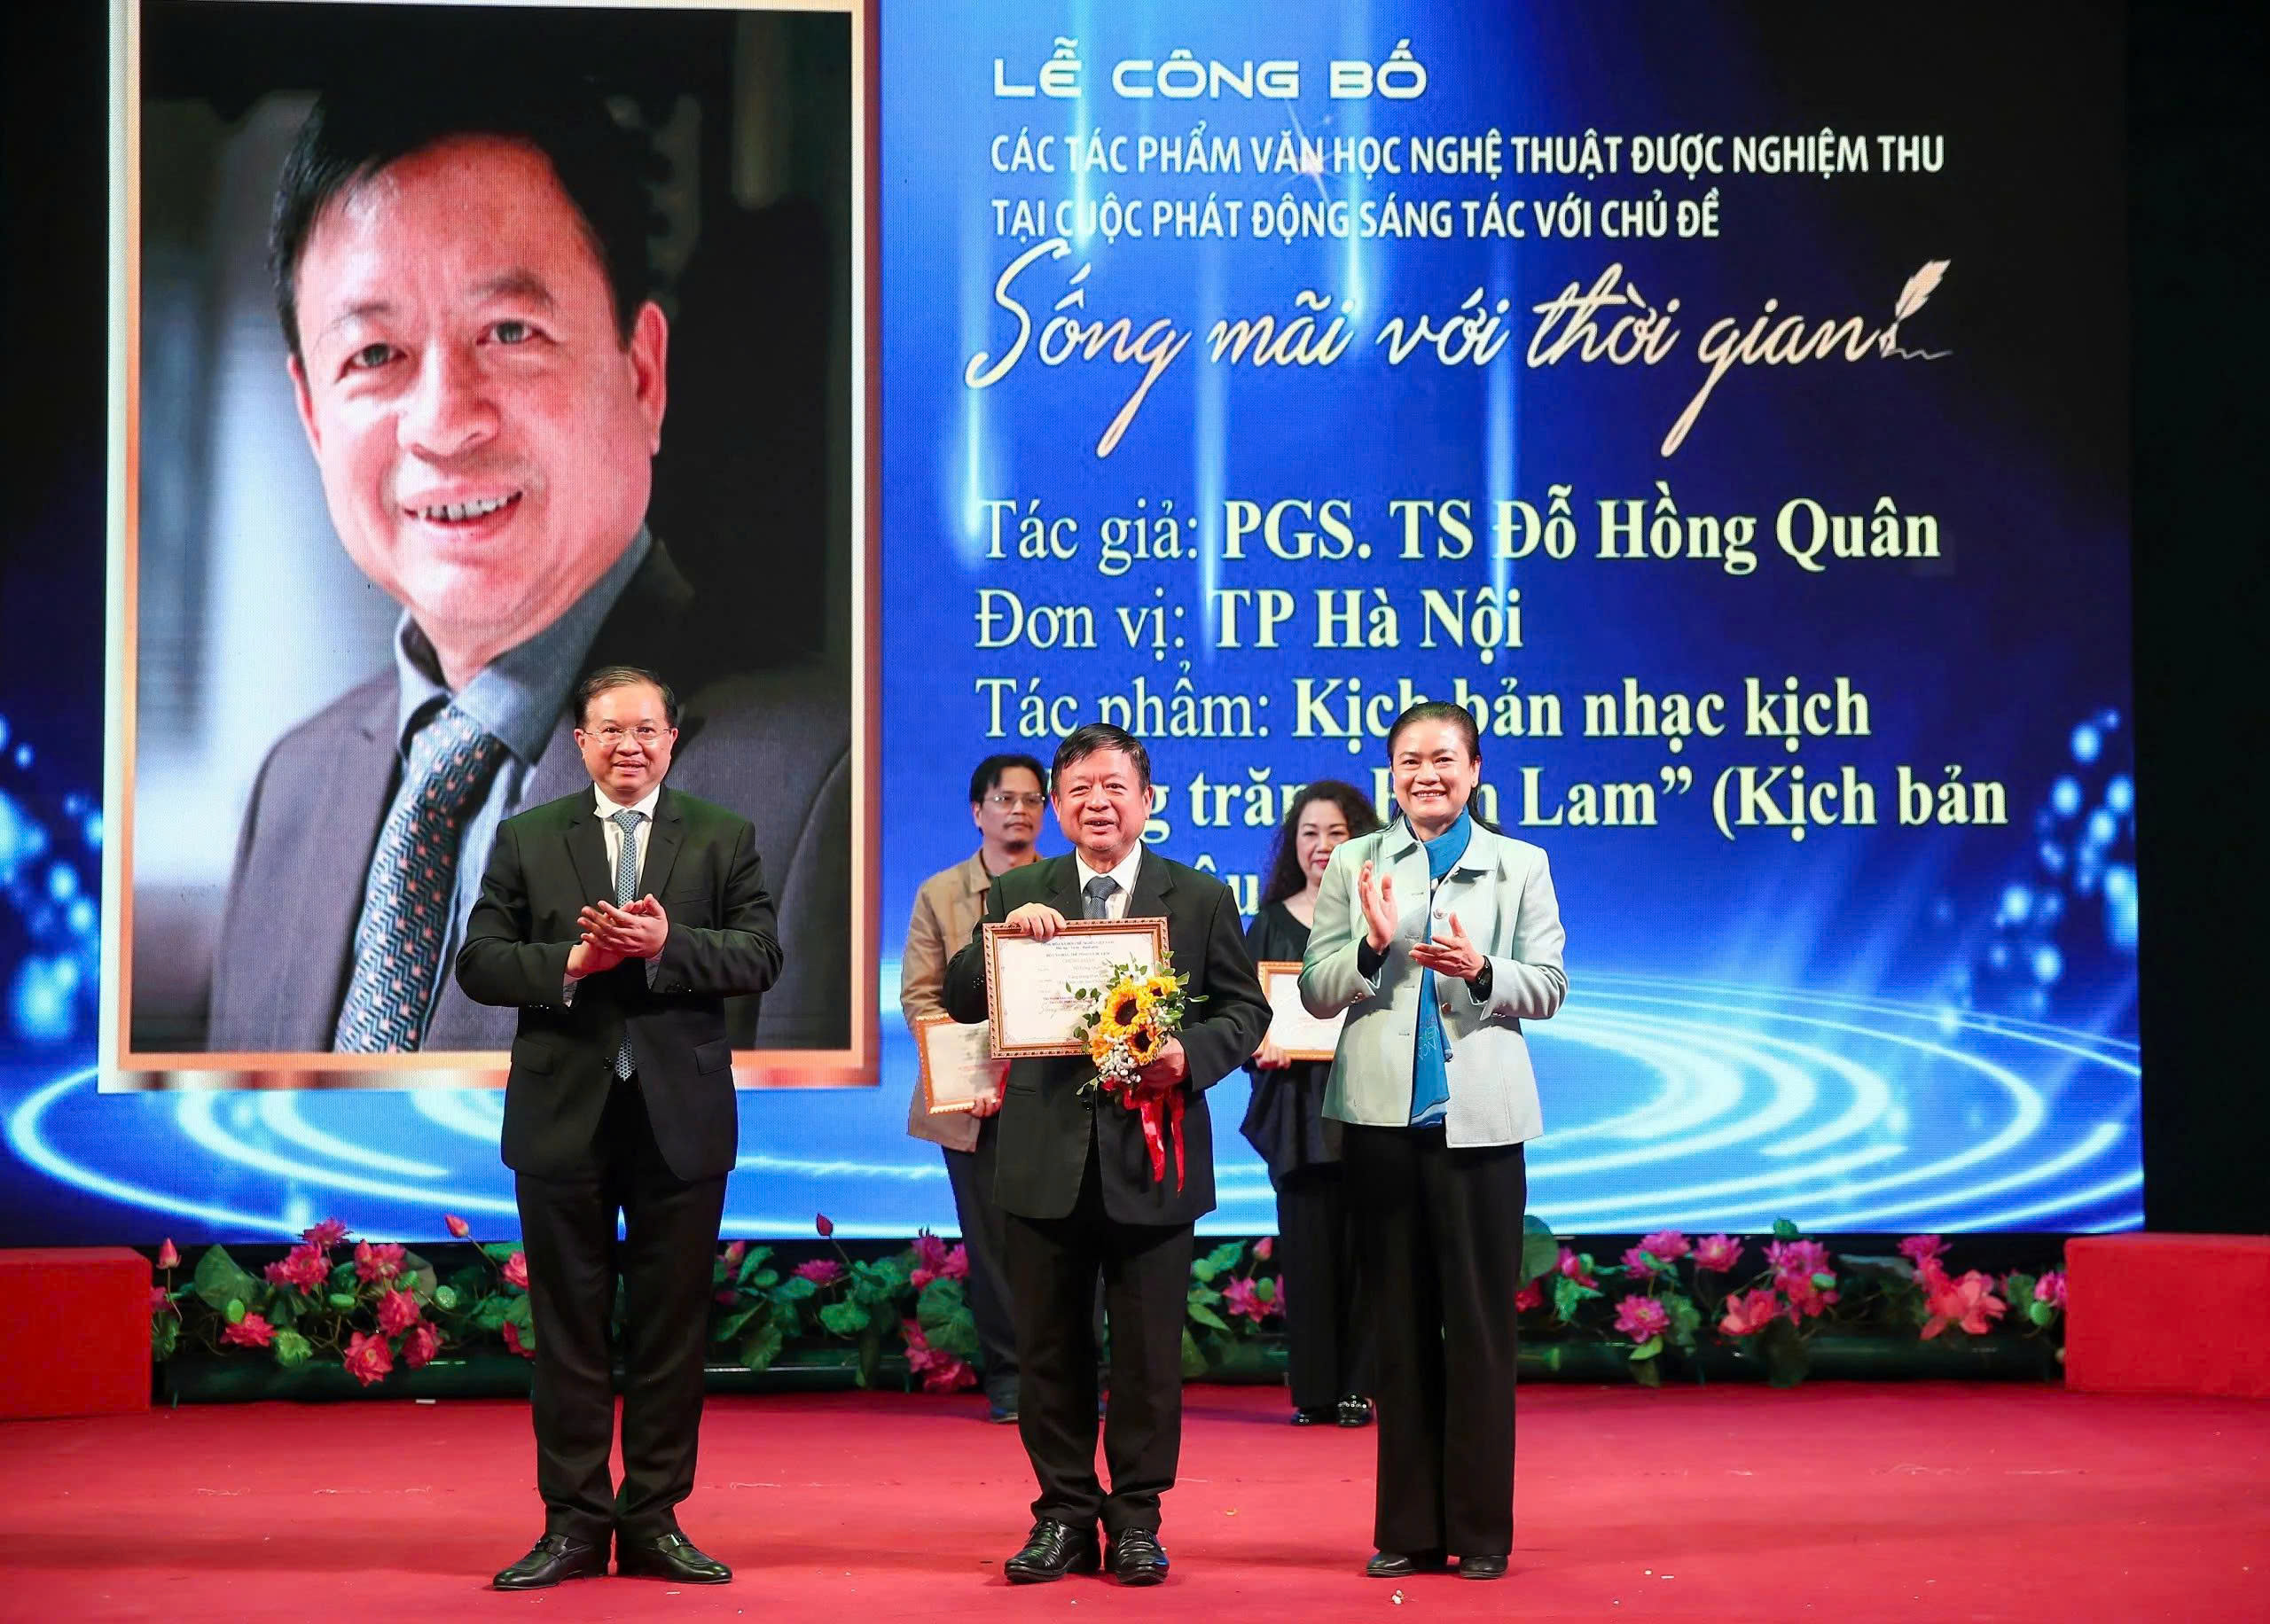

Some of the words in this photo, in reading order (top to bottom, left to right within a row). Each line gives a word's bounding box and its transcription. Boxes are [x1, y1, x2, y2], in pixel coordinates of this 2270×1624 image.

[994, 36, 1083, 98] LỄ
[1112, 49, 1300, 98] CÔNG
[1330, 38, 1428, 98] BỐ
[990, 128, 1055, 174] CÁC
[1065, 128, 1128, 174] TÁC
[1138, 121, 1241, 174] PHẨM
[1250, 129, 1324, 174] VĂN
[1335, 136, 1401, 180] HỌC
[1411, 128, 1503, 180] NGHỆ
[1511, 128, 1623, 181] THUẬT
[1631, 133, 1724, 181] ĐƯỢC
[1733, 127, 1869, 179] NGHIỆM
[1877, 135, 1945, 173] THU
[991, 199, 1045, 244] TẠI
[1055, 192, 1143, 245] CUỘC
[1153, 192, 1243, 238] PHÁT
[1251, 192, 1350, 245] ĐỘNG
[1359, 192, 1453, 238] SÁNG
[1461, 192, 1525, 238] TÁC
[1533, 191, 1592, 238] VỚI
[1601, 189, 1668, 238] CHỦ
[1676, 187, 1720, 238] ĐỀ
[965, 238, 1192, 458] Sống
[1207, 290, 1356, 366] mãi
[1376, 286, 1509, 366] với
[1527, 262, 1680, 368] thời
[1660, 299, 1881, 457] gian
[976, 499, 1078, 560] Tác
[1099, 498, 1199, 575] giả:
[1222, 499, 1371, 560] PGS.
[1389, 499, 1475, 560] TS
[1491, 484, 1577, 559] Đỗ
[1595, 480, 1758, 575] Hồng
[1776, 496, 1941, 572] Quân
[975, 589, 1097, 648] Đơn
[1115, 588, 1186, 660] vị:
[1209, 589, 1295, 648] TP
[1313, 589, 1400, 649] Hà
[1421, 585, 1522, 665] Nội
[976, 677, 1078, 738] Tác
[1584, 677, 1725, 753] nhạc
[1744, 675, 1872, 753] kịch
[1519, 765, 1693, 825] Lam”
[1712, 765, 1877, 842] (Kịch
[1897, 765, 2008, 825] bản
